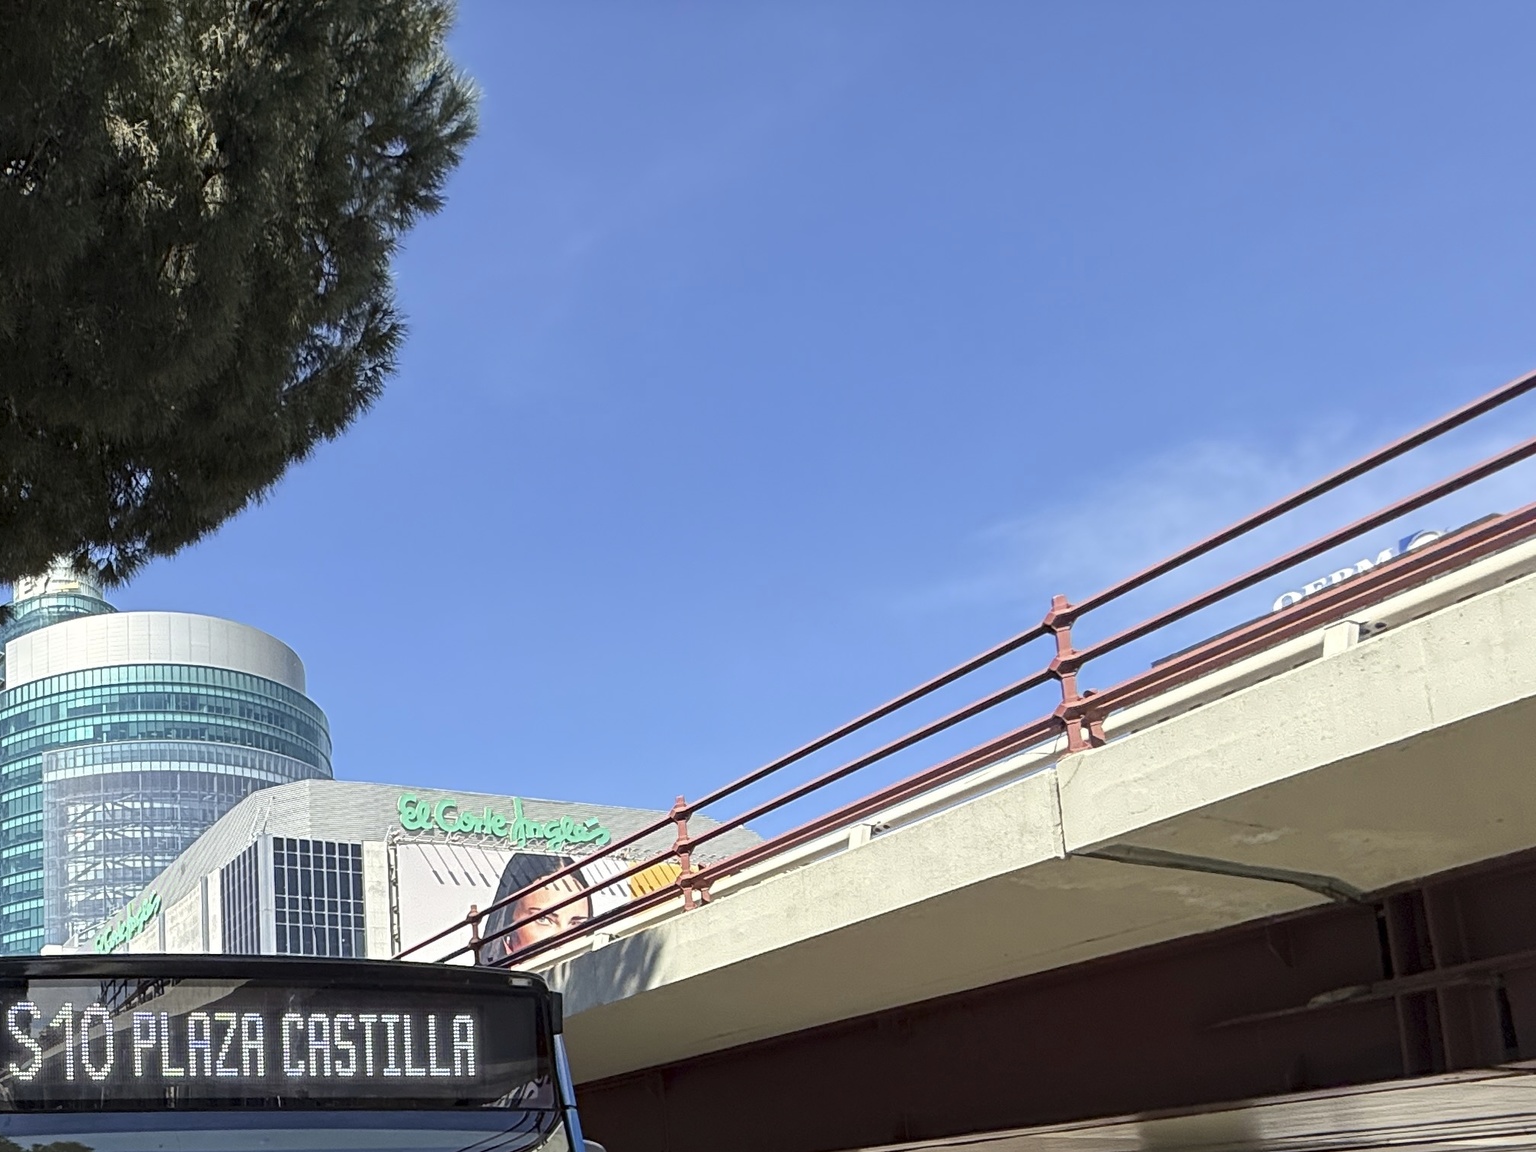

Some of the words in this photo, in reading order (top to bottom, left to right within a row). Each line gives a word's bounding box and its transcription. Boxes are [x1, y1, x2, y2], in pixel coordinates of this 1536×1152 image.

[397, 793, 433, 831] El
[434, 799, 508, 837] Corte
[509, 797, 610, 851] Inglés
[7, 1001, 114, 1081] S10
[133, 1011, 265, 1077] PLAZA
[282, 1013, 476, 1078] CASTILLA
